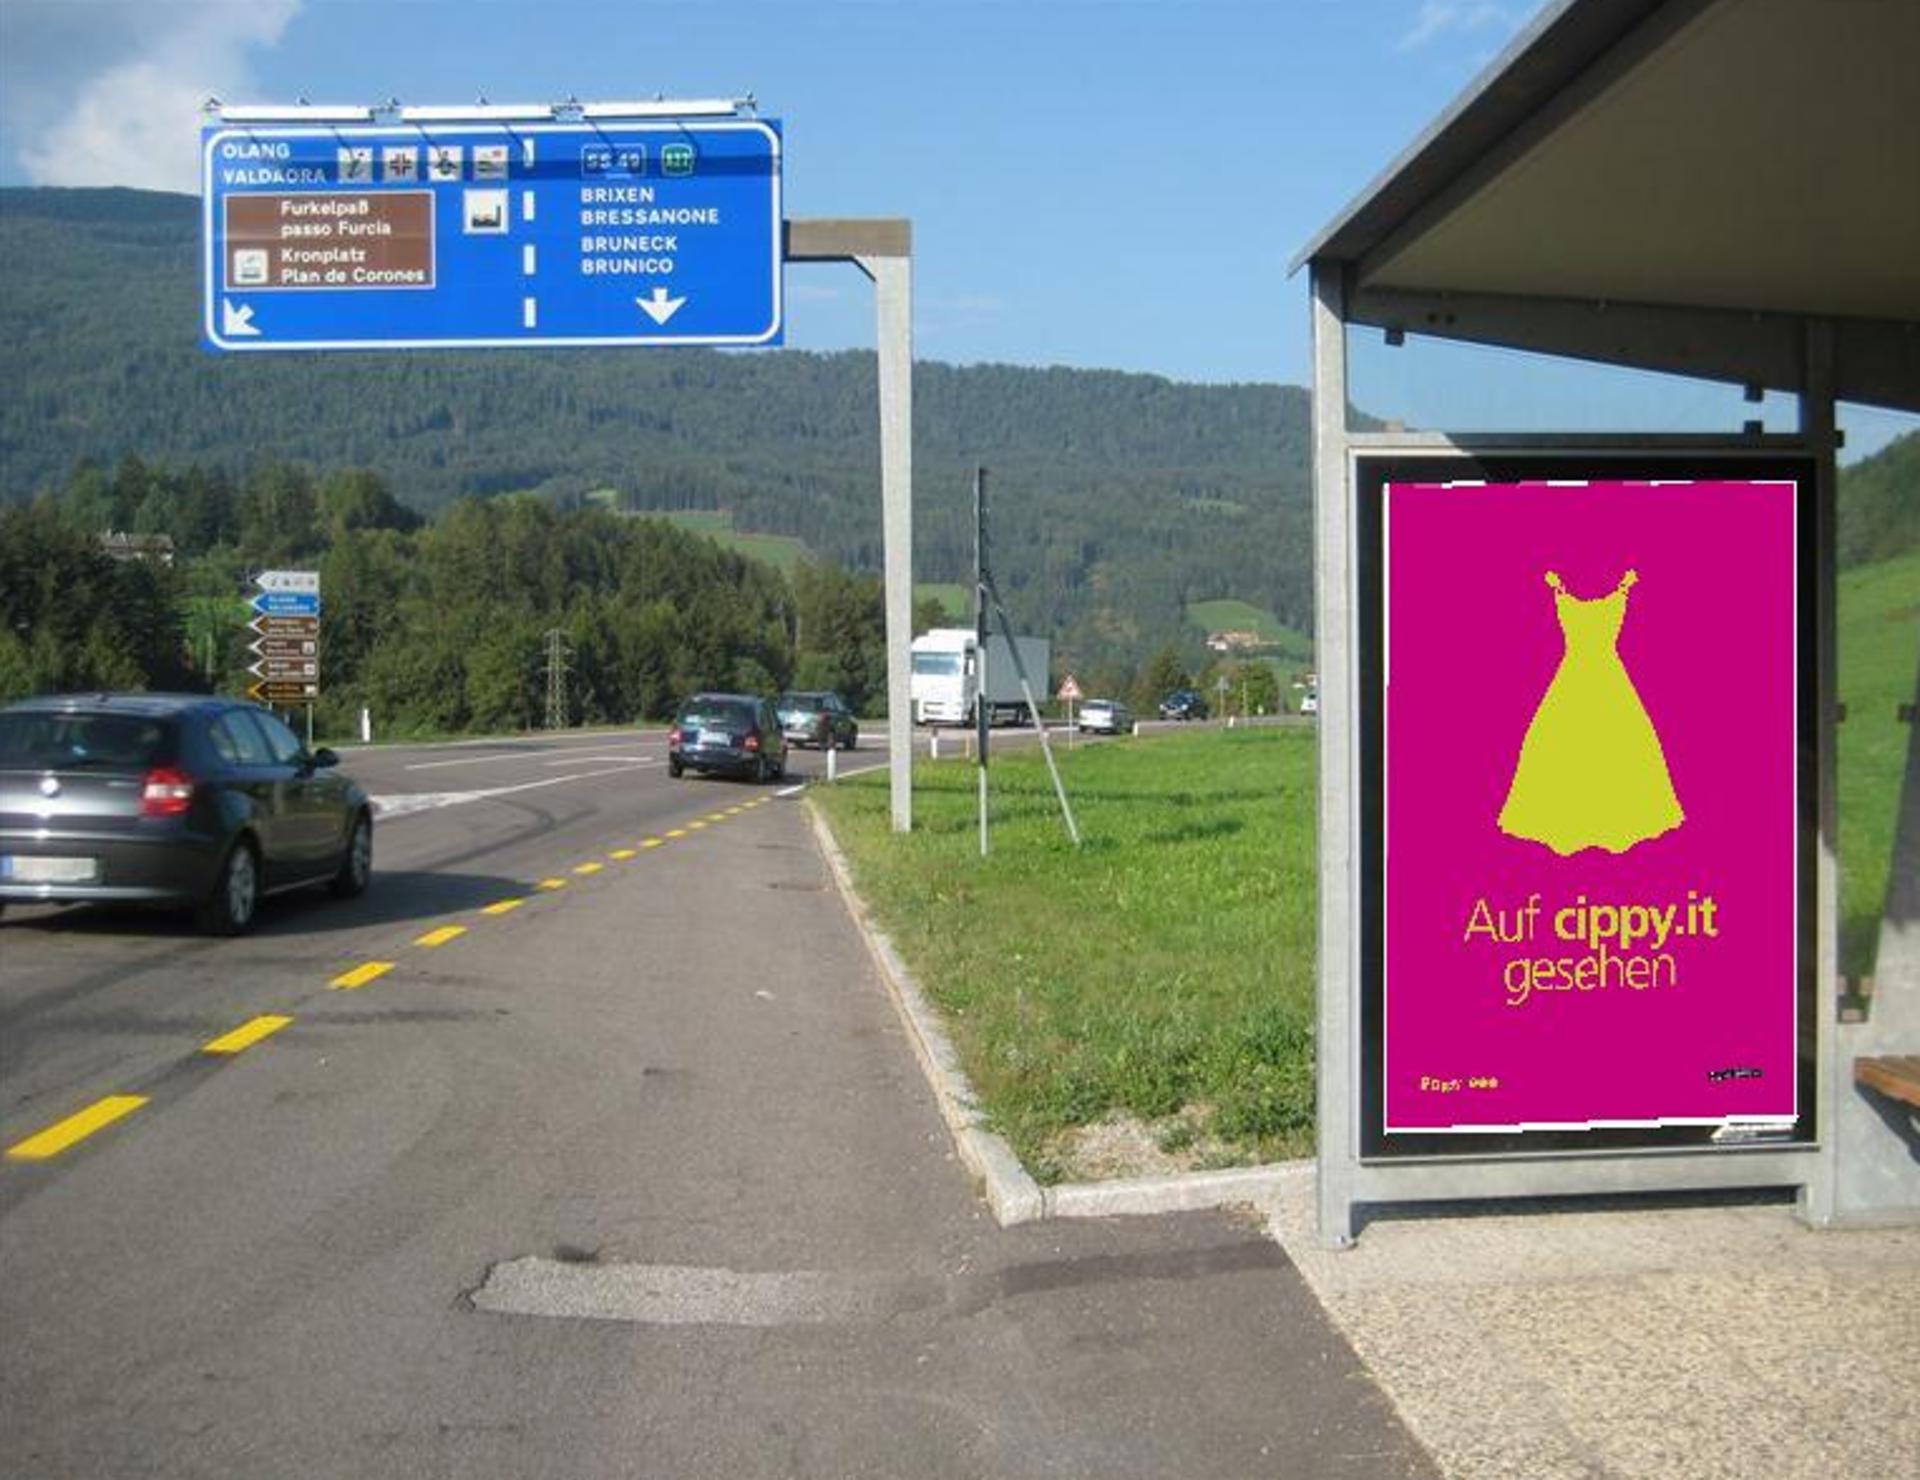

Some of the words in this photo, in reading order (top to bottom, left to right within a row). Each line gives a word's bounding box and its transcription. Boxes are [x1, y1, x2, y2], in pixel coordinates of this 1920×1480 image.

[222, 143, 290, 159] OLANG
[223, 168, 327, 185] VALDAORA
[581, 188, 654, 203] BRIXEN
[581, 209, 719, 225] BRESSANONE
[281, 224, 332, 238] passo
[338, 221, 391, 236] Furcia
[581, 236, 678, 252] BRUNECK
[281, 248, 366, 264] Kronplatz
[581, 259, 674, 275] BRUNICO
[281, 269, 321, 284] Plan
[325, 269, 346, 283] de
[353, 267, 424, 283] Corones
[1463, 894, 1542, 943] Auf
[1554, 890, 1719, 949] cippy.it
[1504, 944, 1677, 1006] gesehen
